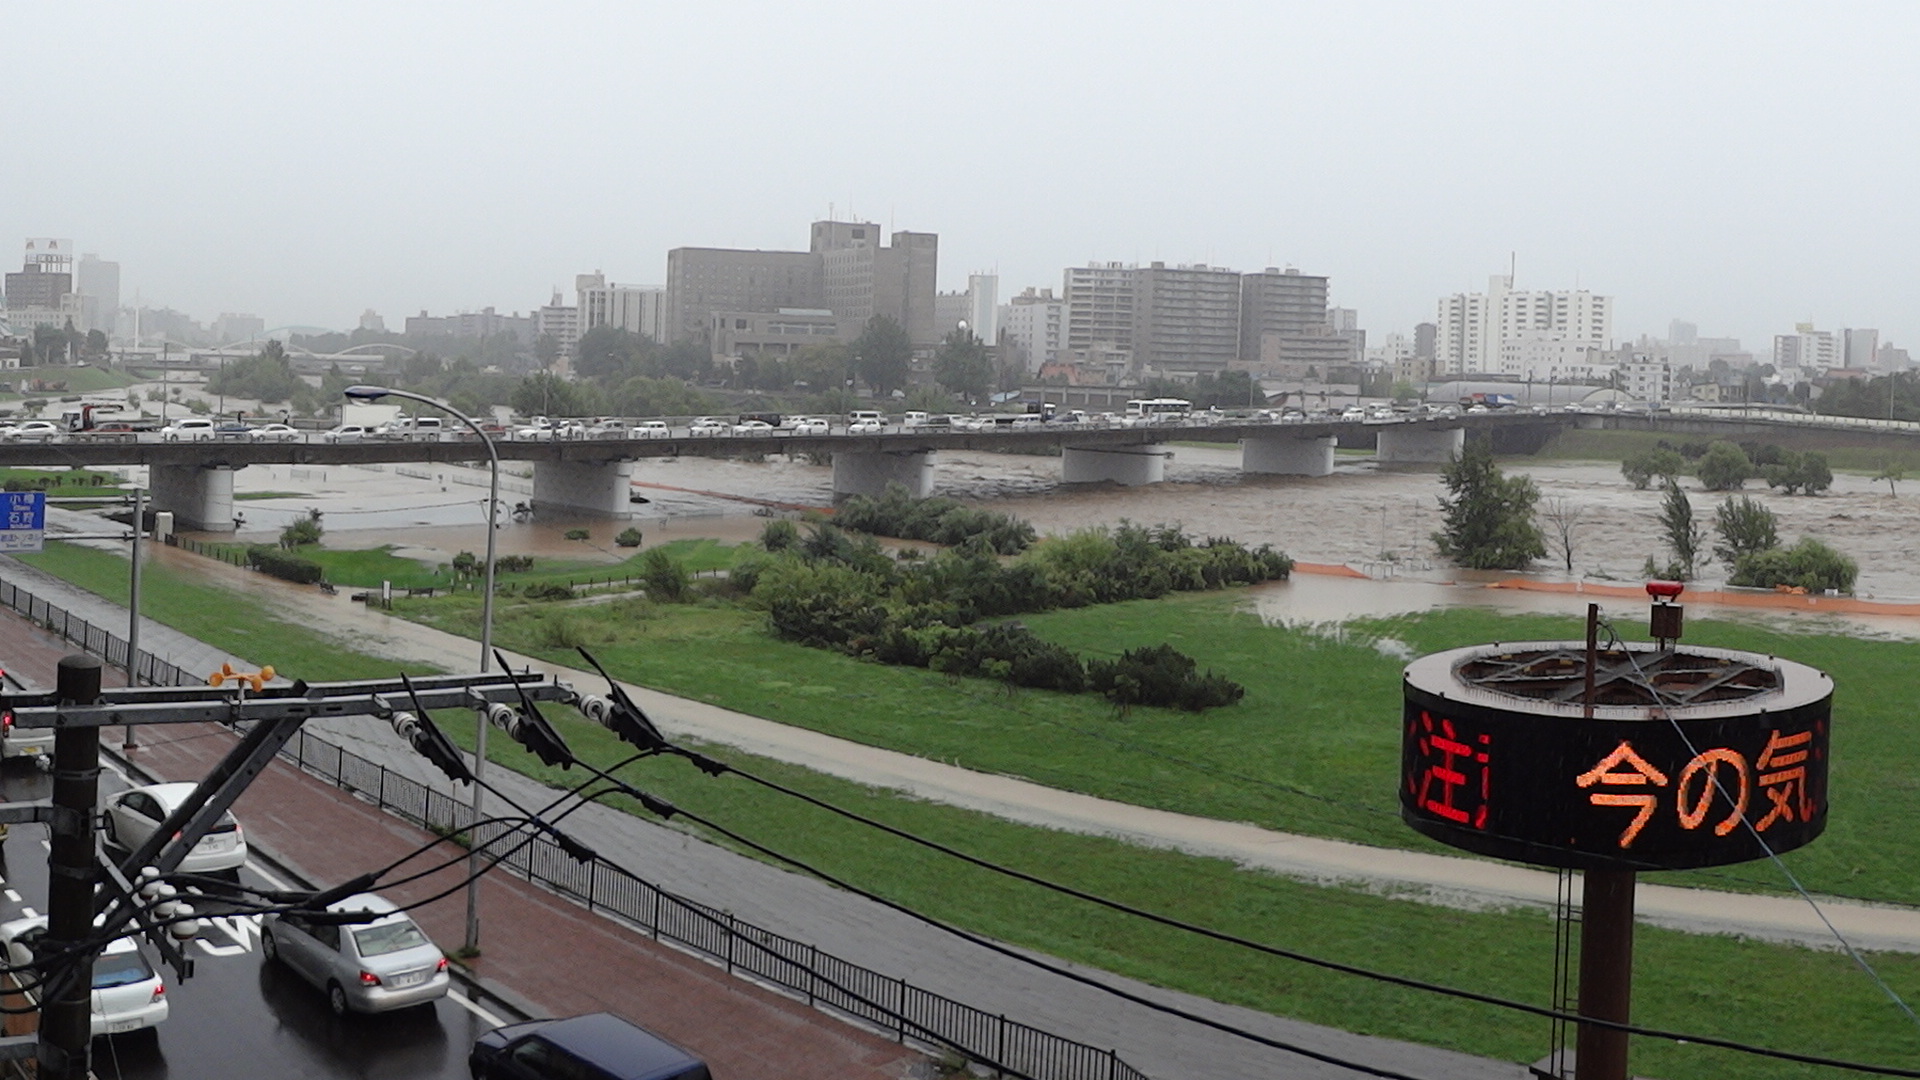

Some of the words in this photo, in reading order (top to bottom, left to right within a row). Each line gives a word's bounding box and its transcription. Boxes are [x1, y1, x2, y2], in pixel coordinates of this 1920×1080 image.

[1418, 710, 1491, 829] 注
[1576, 721, 1824, 849] 今の気
